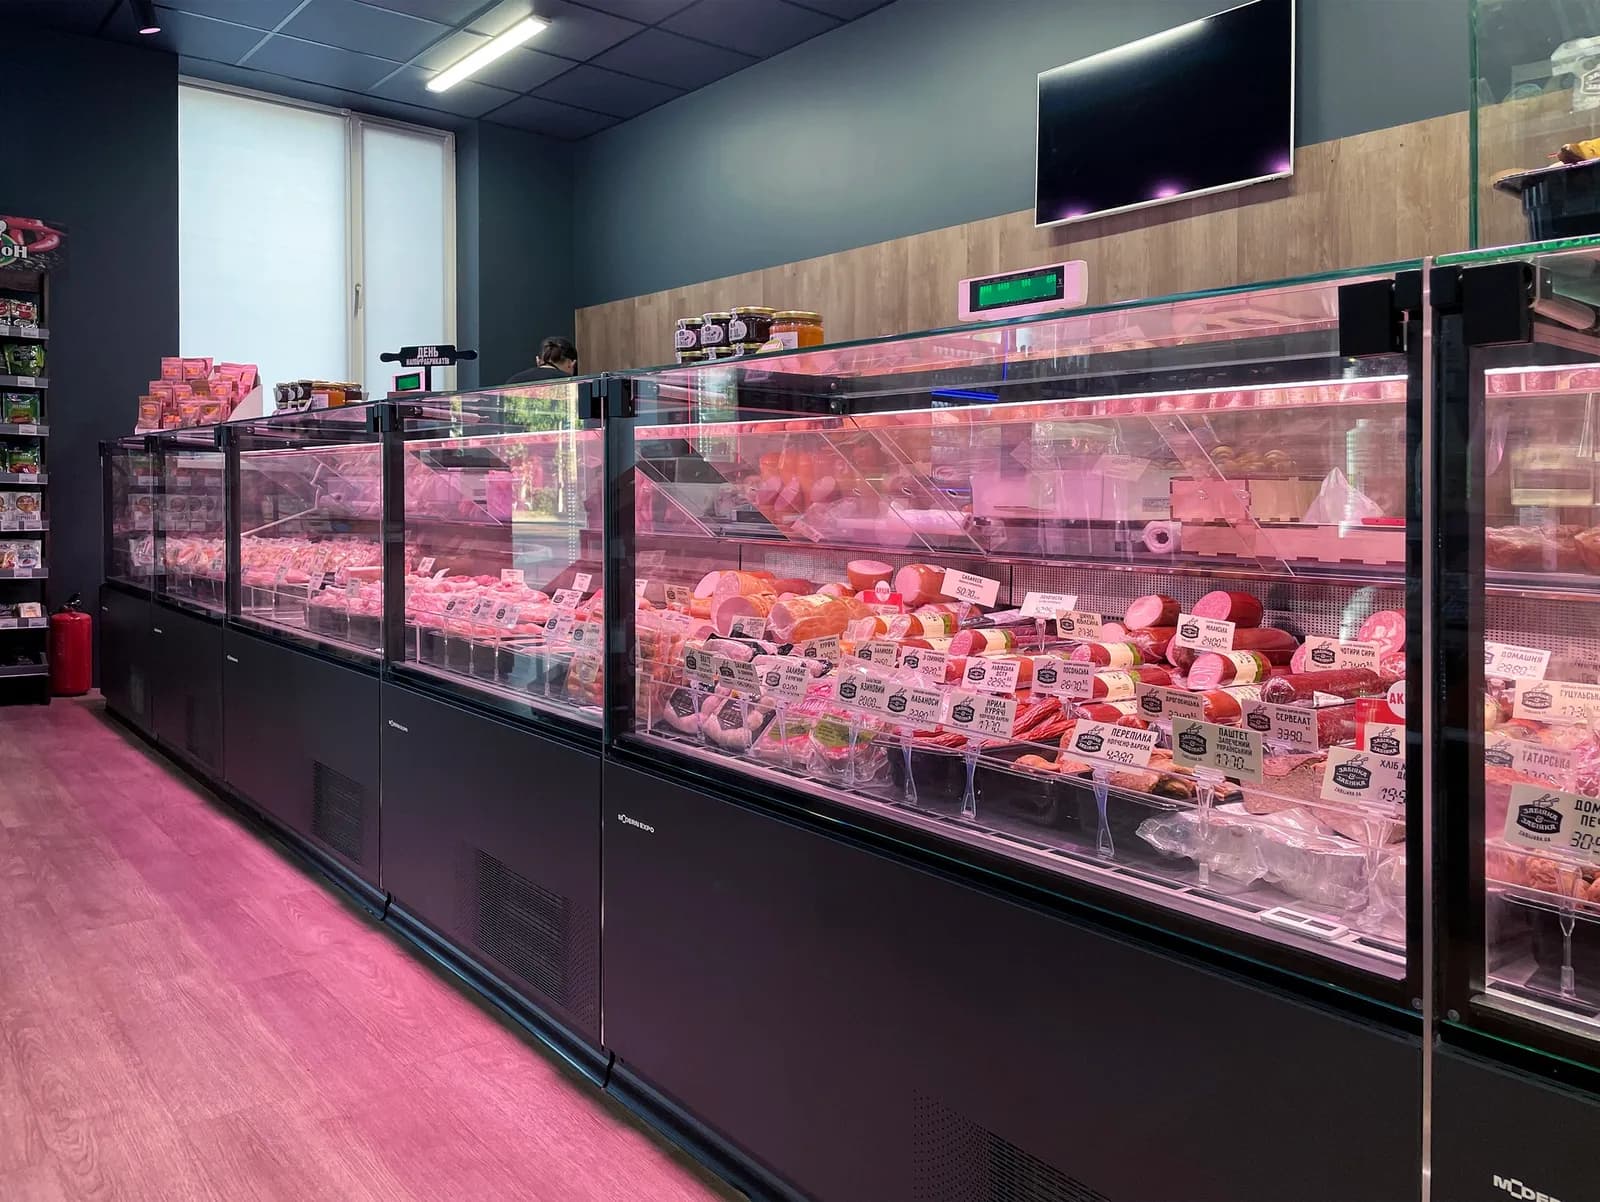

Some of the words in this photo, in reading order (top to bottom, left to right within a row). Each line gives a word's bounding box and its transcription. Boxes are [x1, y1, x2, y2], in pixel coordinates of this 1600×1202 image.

[417, 346, 439, 358] ДЕНЬ
[1501, 651, 1543, 663] ДОМАШНЯ
[911, 695, 939, 707] КАБАНОСИ
[986, 700, 1006, 709] КРИЛА
[984, 707, 1006, 716] КУРЯЧІ
[1275, 712, 1312, 726] СЕРВЕЛАТ
[1111, 728, 1152, 743] ПЕРЕПІЛКА
[1218, 728, 1249, 741] ПАШТЕТ
[1380, 759, 1399, 770] ХЛІБ
[1522, 750, 1570, 769] ТАТАРСЬКА
